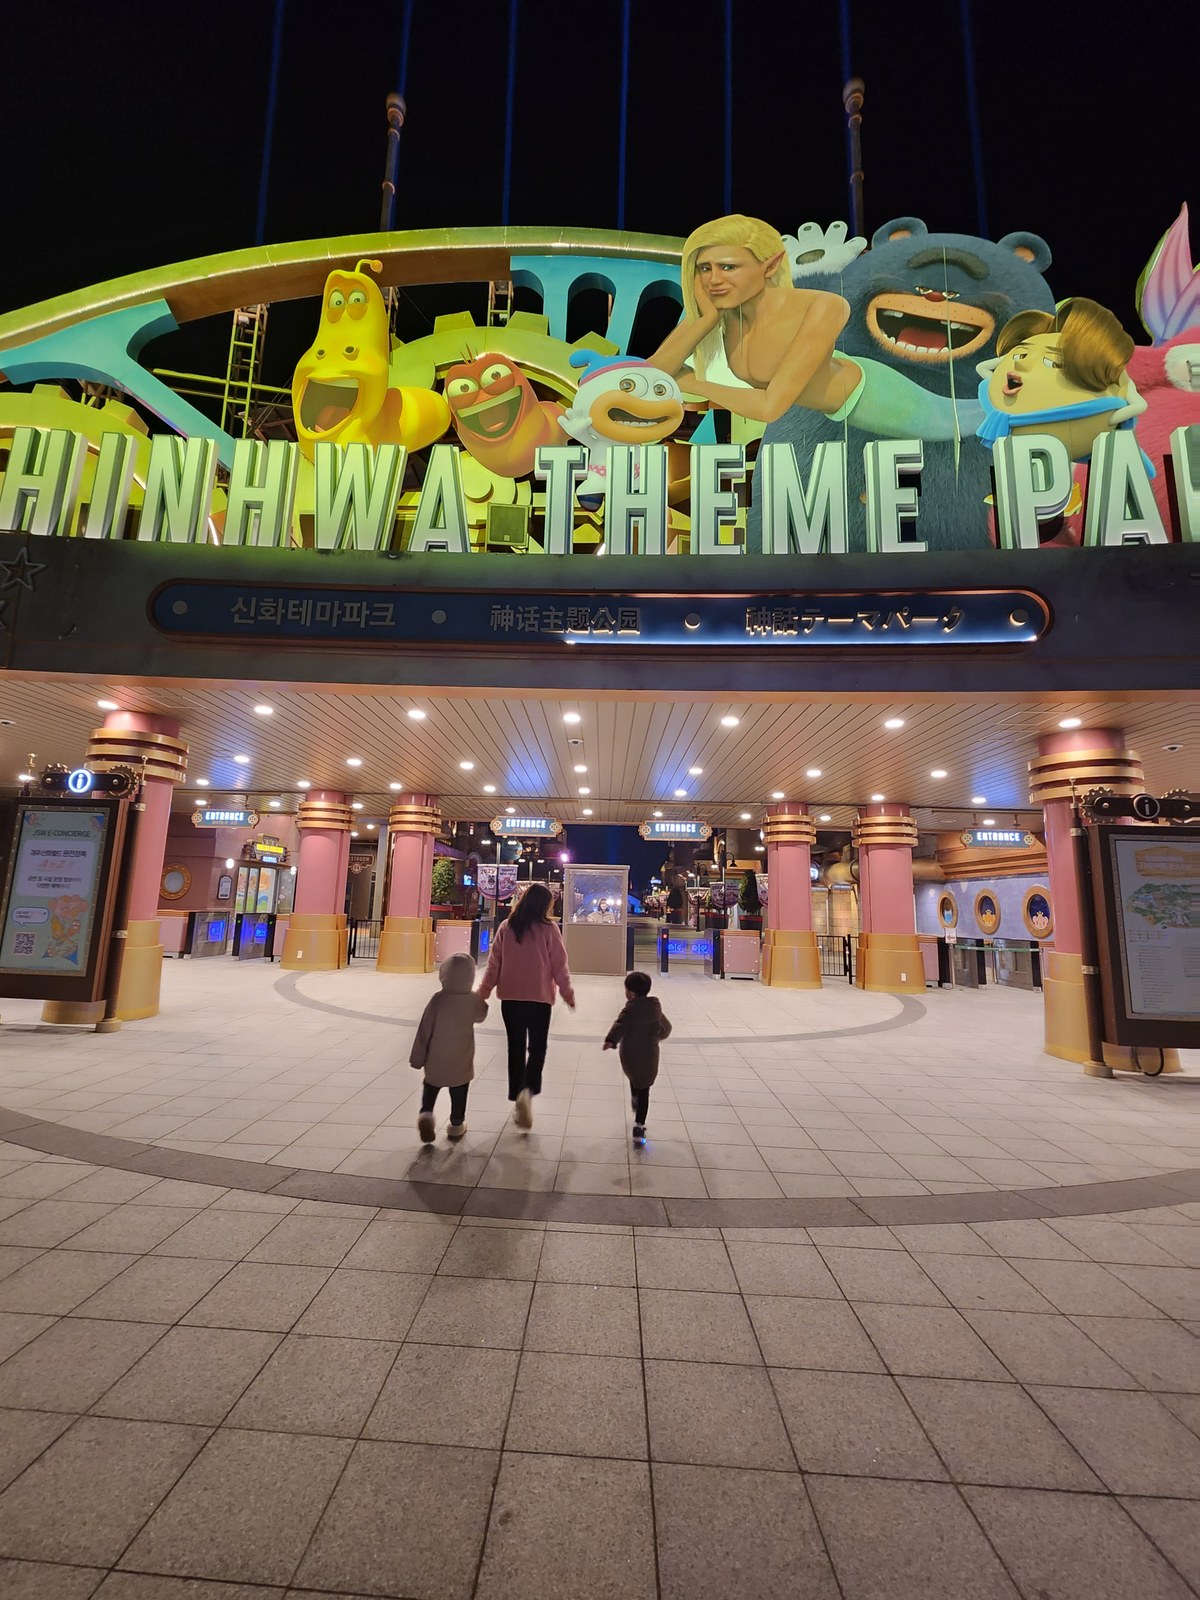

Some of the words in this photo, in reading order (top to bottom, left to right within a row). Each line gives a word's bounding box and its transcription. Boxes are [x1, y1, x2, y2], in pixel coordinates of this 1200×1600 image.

[534, 439, 928, 555] THEME
[229, 596, 396, 628] 신화테마파크
[489, 604, 641, 635] 神话主题公园
[745, 606, 966, 636] 神話テーマパーク
[205, 811, 245, 821] ENTRANCE
[505, 818, 547, 829] ENTRANCE
[655, 823, 696, 833] ENTRANCE
[976, 832, 1020, 842] ENTRANCE
